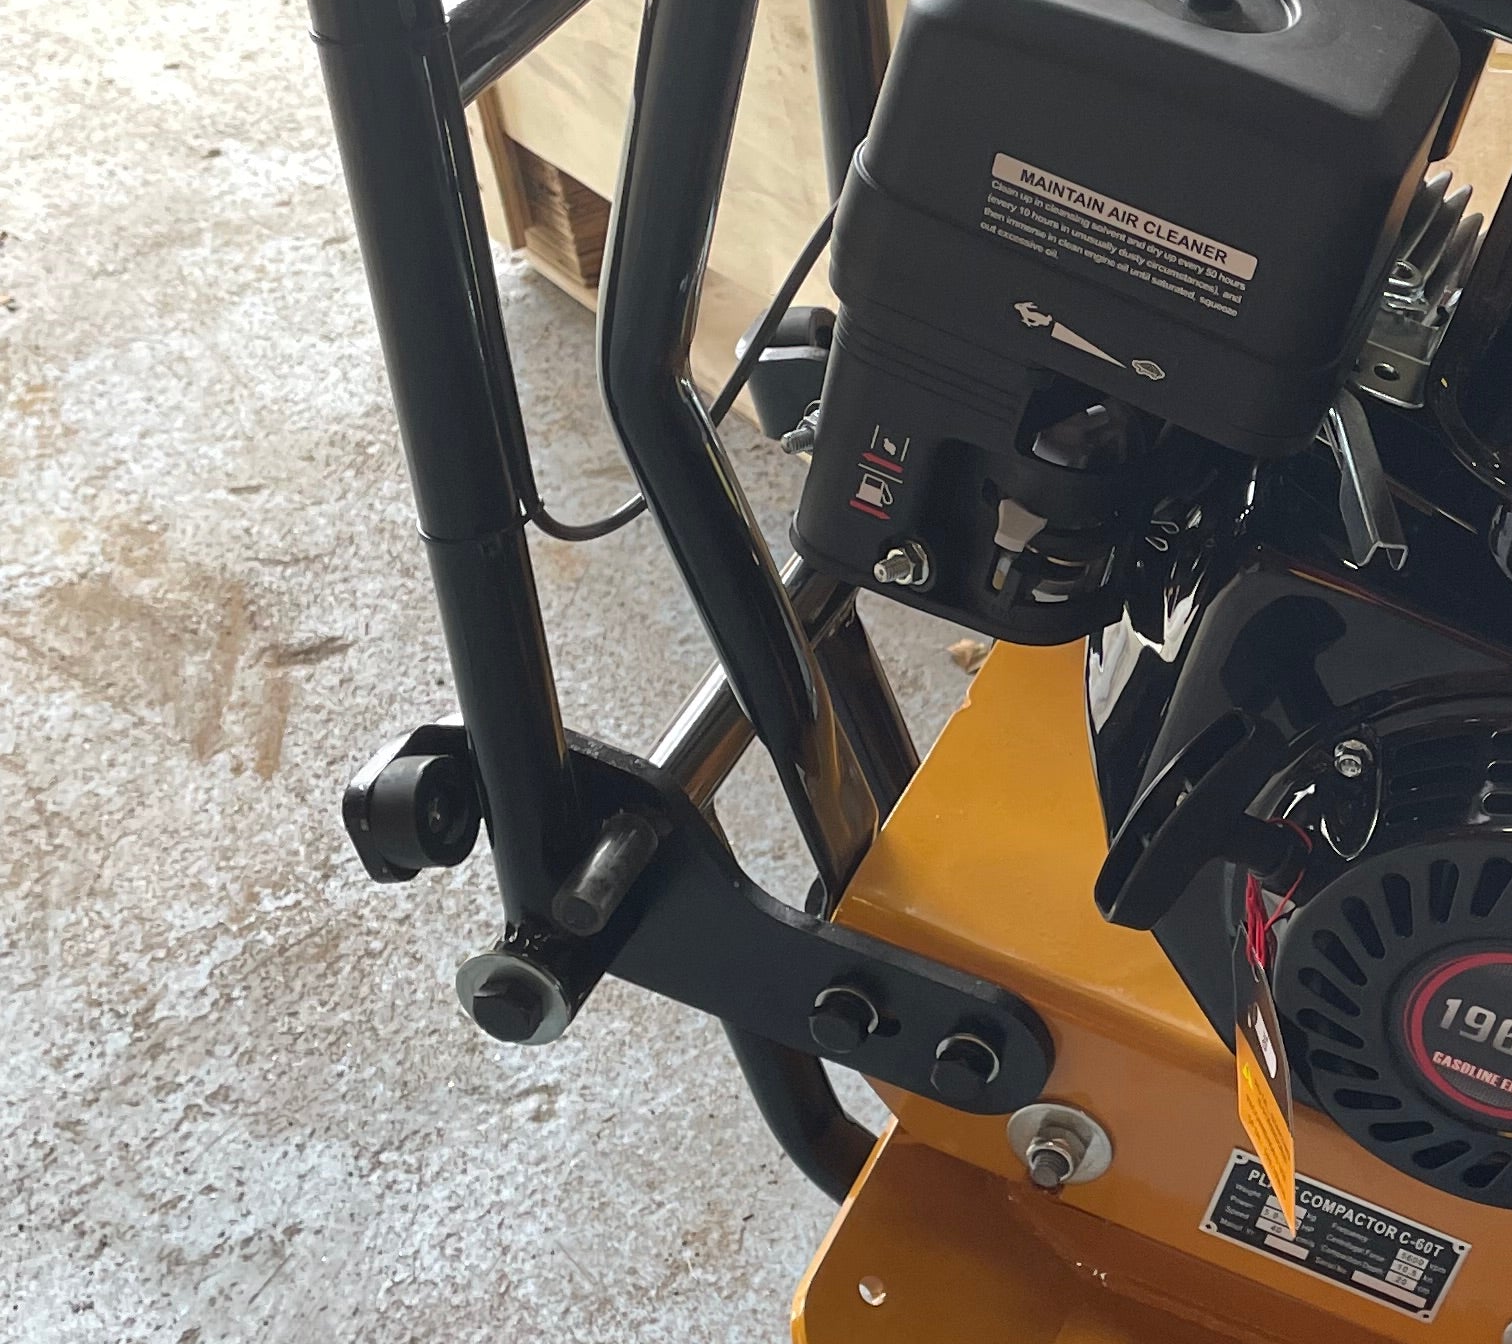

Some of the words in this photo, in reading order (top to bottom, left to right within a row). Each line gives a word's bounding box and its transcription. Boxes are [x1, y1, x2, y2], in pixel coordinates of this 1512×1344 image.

[980, 222, 997, 234] out
[997, 229, 1044, 253] excessive
[983, 206, 1005, 222] then
[1047, 232, 1057, 243] in
[1058, 238, 1083, 254] clean
[1083, 249, 1116, 267] engine
[1129, 268, 1151, 281] until
[1199, 296, 1238, 317] squeeze
[986, 193, 1017, 215] (every
[1019, 206, 1031, 218] 10
[1031, 211, 1060, 229] hours
[1060, 223, 1070, 234] in
[1071, 229, 1118, 256] unusually
[1118, 247, 1146, 267] dusty
[1223, 291, 1242, 304] and
[991, 179, 1019, 197] Clean
[1020, 193, 1034, 206] up
[1034, 197, 1044, 208] in
[1091, 222, 1127, 242] solvent
[1127, 237, 1146, 250] and
[1146, 243, 1163, 260] dry
[1163, 252, 1177, 265] up
[1177, 258, 1205, 277] every
[1205, 268, 1218, 279] 50
[1218, 273, 1246, 291] hours
[1020, 169, 1105, 213] MAINTAIN
[1108, 205, 1140, 227] AIR
[1143, 219, 1228, 264] CLEANER
[1432, 1051, 1500, 1087] GASOLINE
[1300, 1190, 1398, 1240] COMPACTOR
[1399, 1231, 1444, 1257] C-60T
